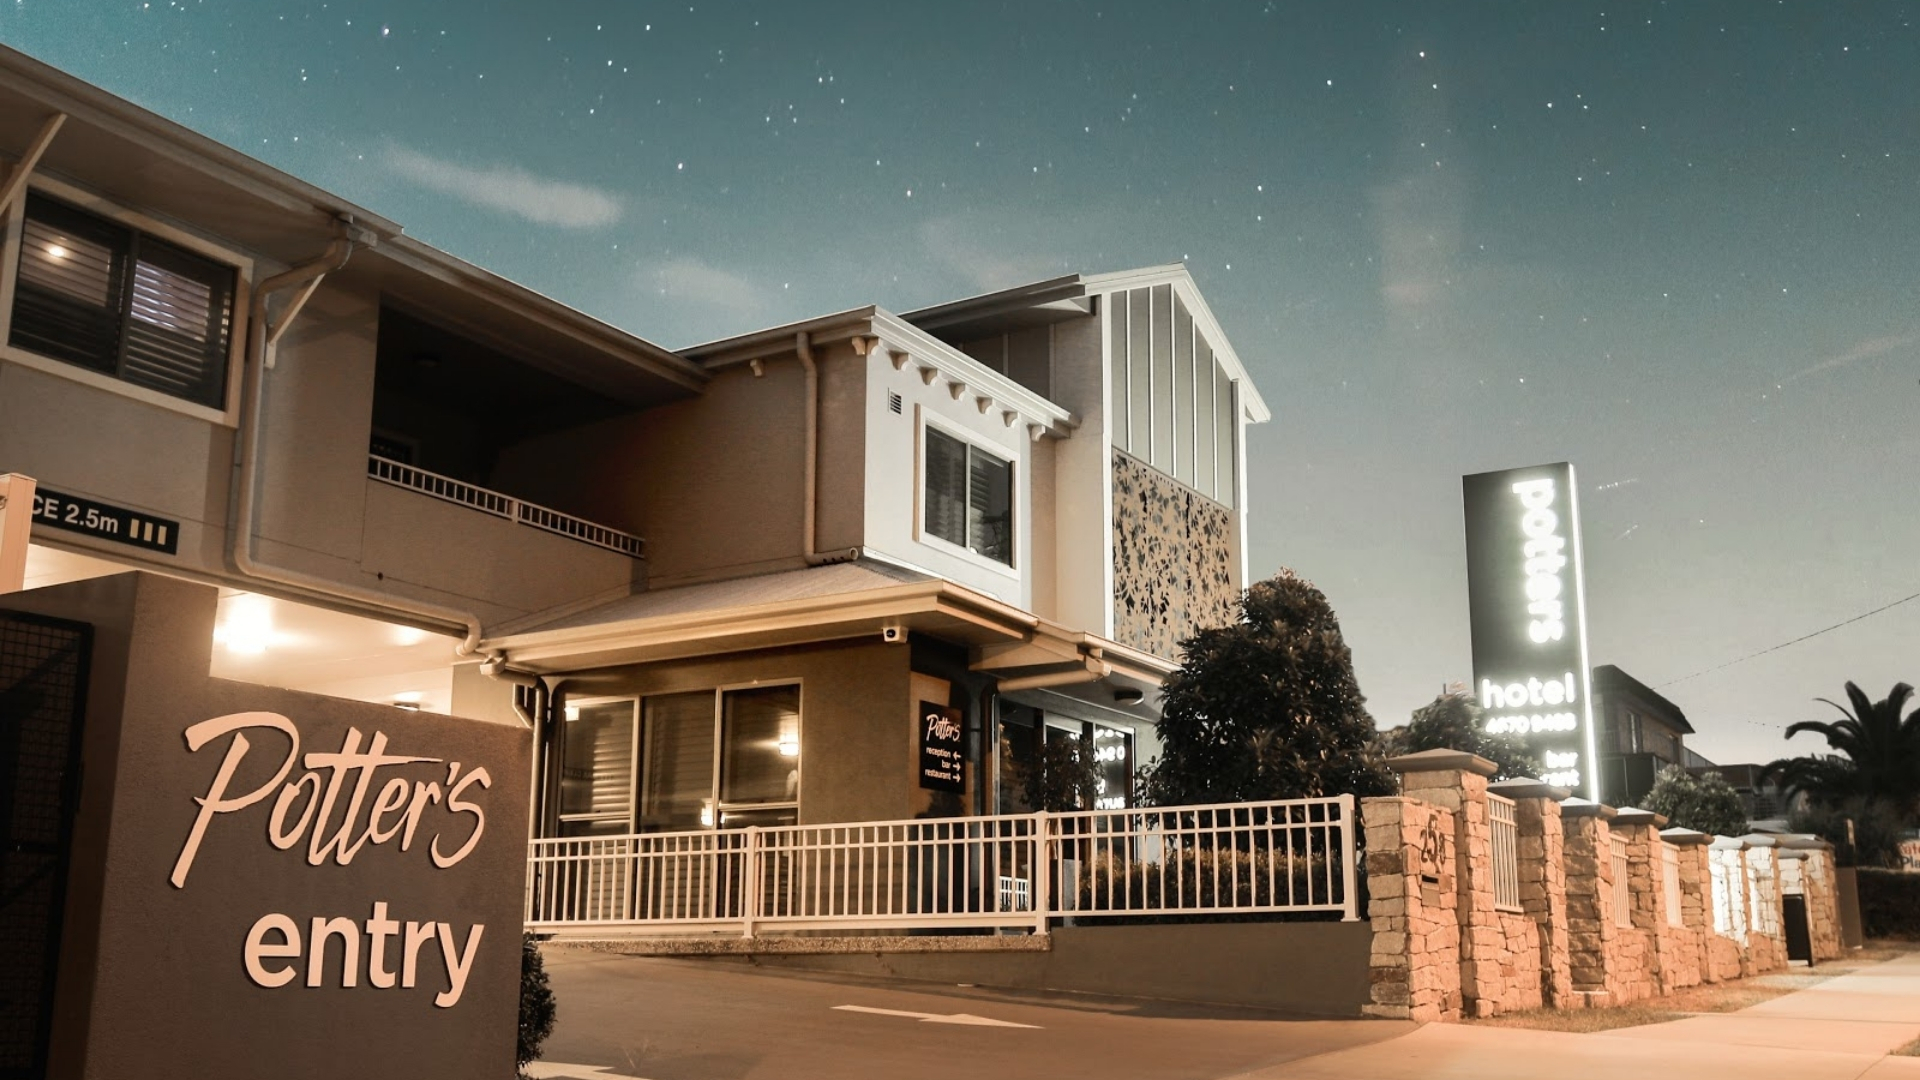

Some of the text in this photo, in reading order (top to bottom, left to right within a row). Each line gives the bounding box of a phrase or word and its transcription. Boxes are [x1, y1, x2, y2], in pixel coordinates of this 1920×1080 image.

[64, 503, 119, 534] 2.5m
[1511, 478, 1566, 644] potters
[1481, 671, 1576, 709] hotel
[926, 746, 952, 759] reception
[941, 759, 952, 769] bar
[924, 768, 952, 781] restaurant
[170, 711, 492, 888] Potter's
[243, 901, 485, 1008] entry
